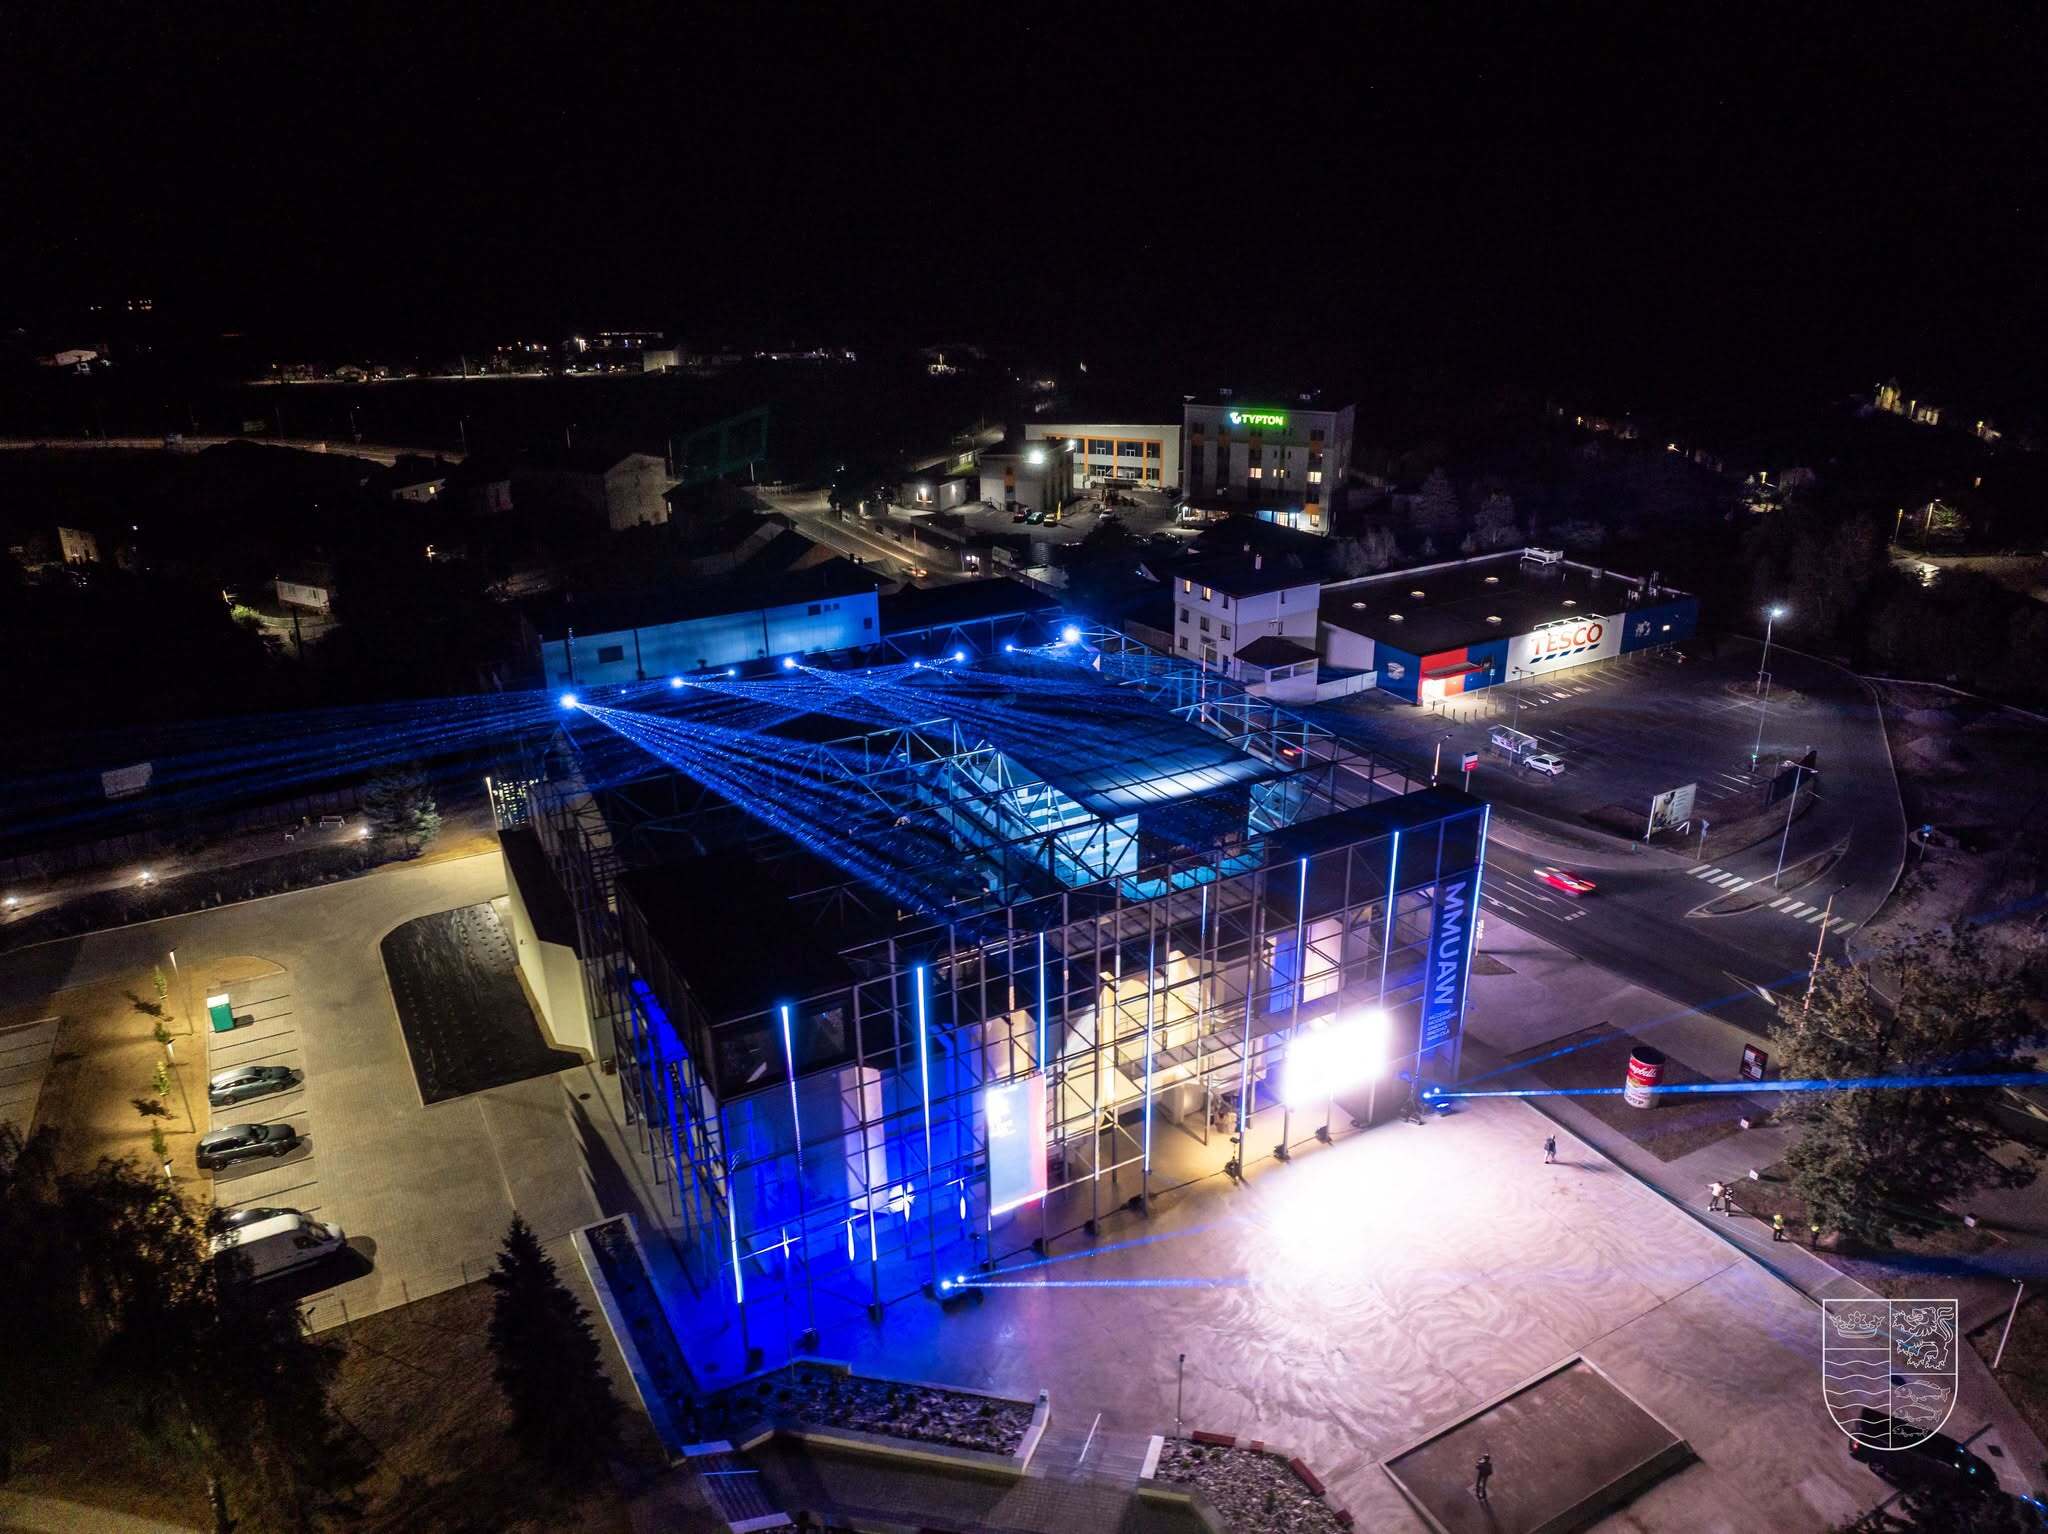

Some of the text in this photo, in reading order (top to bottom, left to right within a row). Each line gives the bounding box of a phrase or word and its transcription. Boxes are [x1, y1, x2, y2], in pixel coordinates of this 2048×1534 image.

[1241, 413, 1284, 426] TYPTON
[1530, 623, 1603, 656] TESCO
[1434, 880, 1467, 1005] MMUAW
